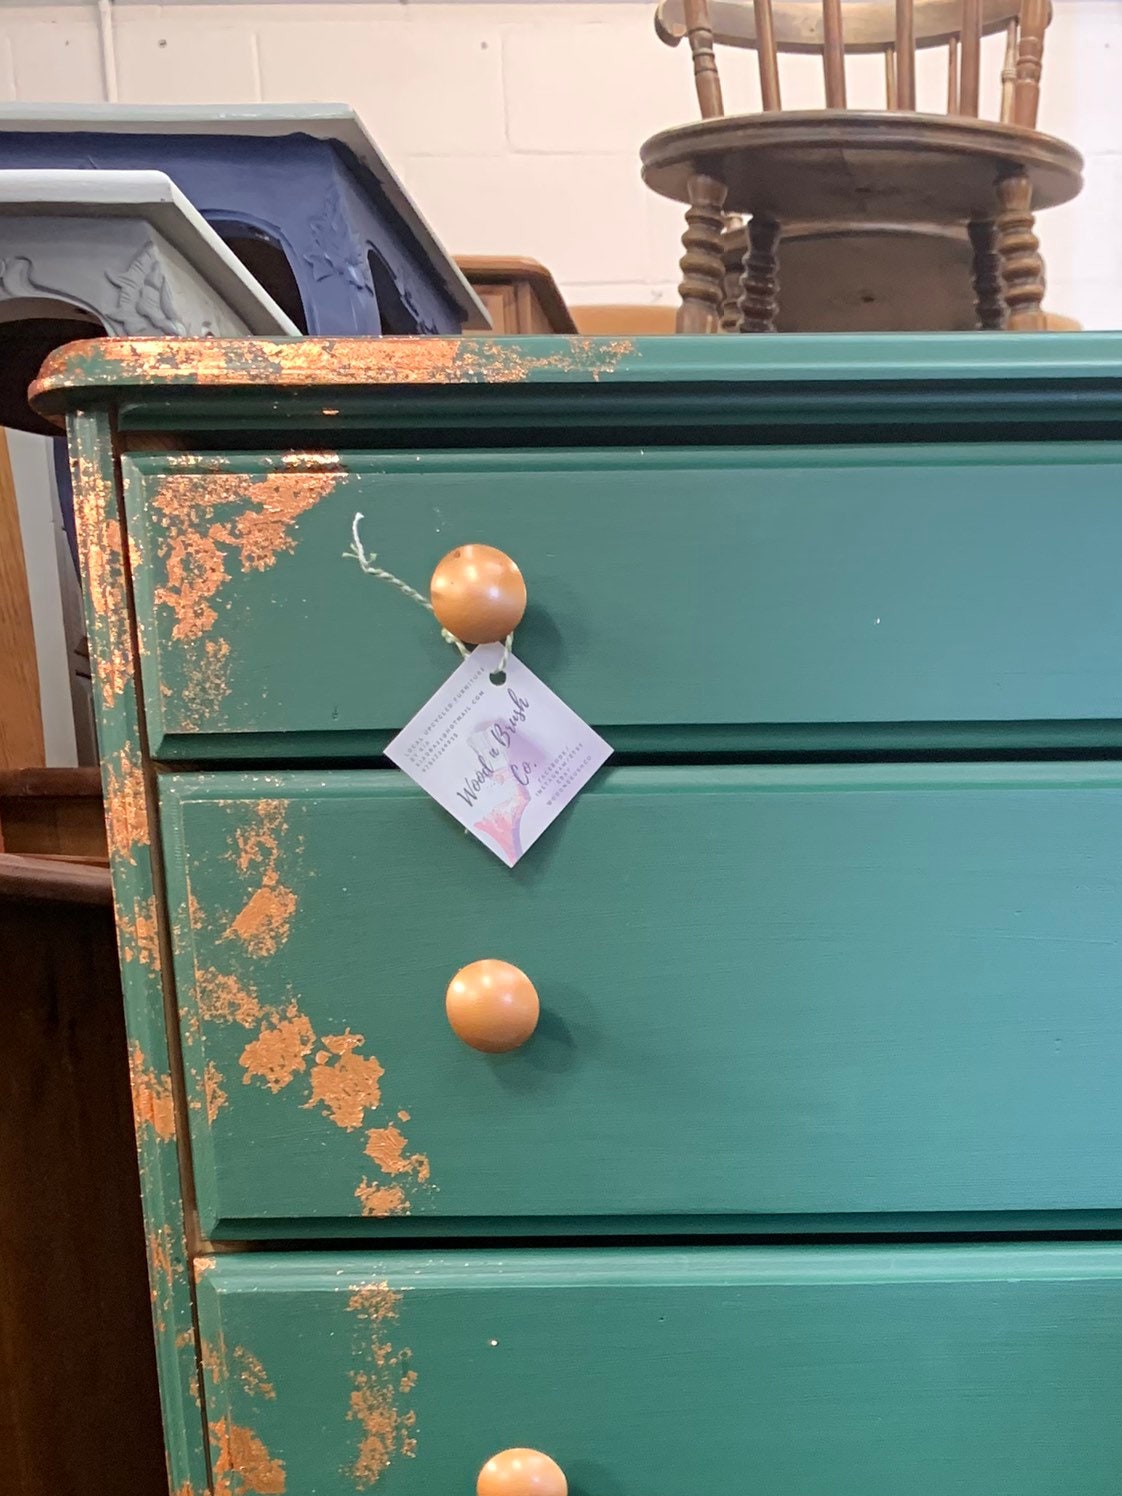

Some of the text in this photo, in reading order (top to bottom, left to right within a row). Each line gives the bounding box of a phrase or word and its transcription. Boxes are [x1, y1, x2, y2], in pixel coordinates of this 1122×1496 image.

[403, 735, 424, 758] LOCAL
[422, 701, 453, 736] UPCYCLED
[451, 665, 485, 703] FURNITURE
[456, 756, 494, 807] Wood
[491, 688, 530, 749] Brush
[511, 762, 538, 786] Co.
